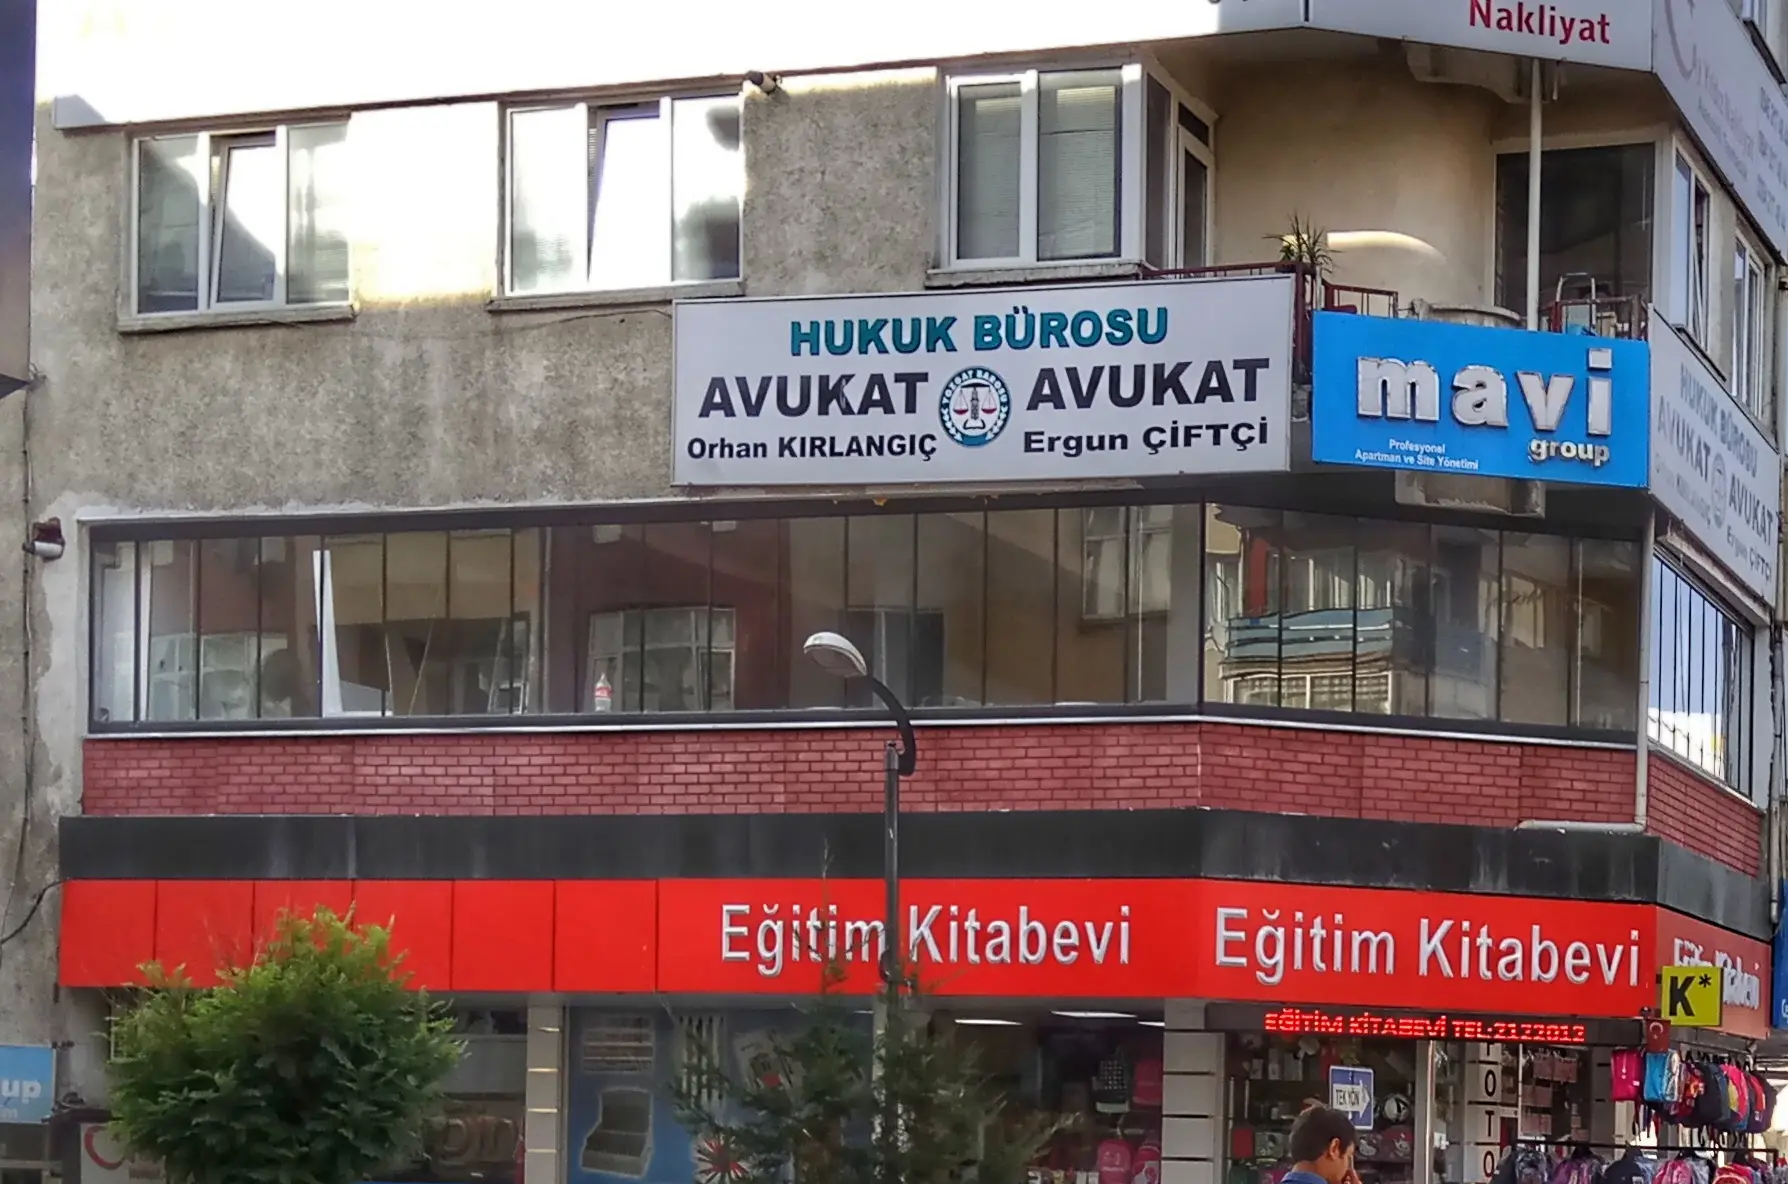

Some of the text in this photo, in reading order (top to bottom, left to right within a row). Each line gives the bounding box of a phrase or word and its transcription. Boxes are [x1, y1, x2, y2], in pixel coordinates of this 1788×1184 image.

[1469, 0, 1610, 45] Nakliyat
[790, 306, 1168, 356] HUKUK BÜROSU
[699, 372, 928, 419] AVUKAT
[1026, 358, 1270, 411] AVUKAT
[1357, 348, 1613, 436] mavi
[687, 434, 937, 462] Orhan KIRLANGIÇ
[1023, 417, 1269, 458] Ergun ÇİFTÇİ
[1355, 449, 1479, 470] Apartman ve Site Yönetimi
[1389, 439, 1445, 454] Profesyonel
[1528, 438, 1610, 466] group
[1657, 396, 1711, 482] AVUKAT
[1729, 473, 1773, 546] AVUKAT
[721, 904, 1130, 977] Eğitim Kitabevi
[1215, 908, 1638, 986] Eğitim Kitabevi
[1265, 1008, 1343, 1034] EĞİTİM
[1350, 1012, 1447, 1037] KİTABEVİ
